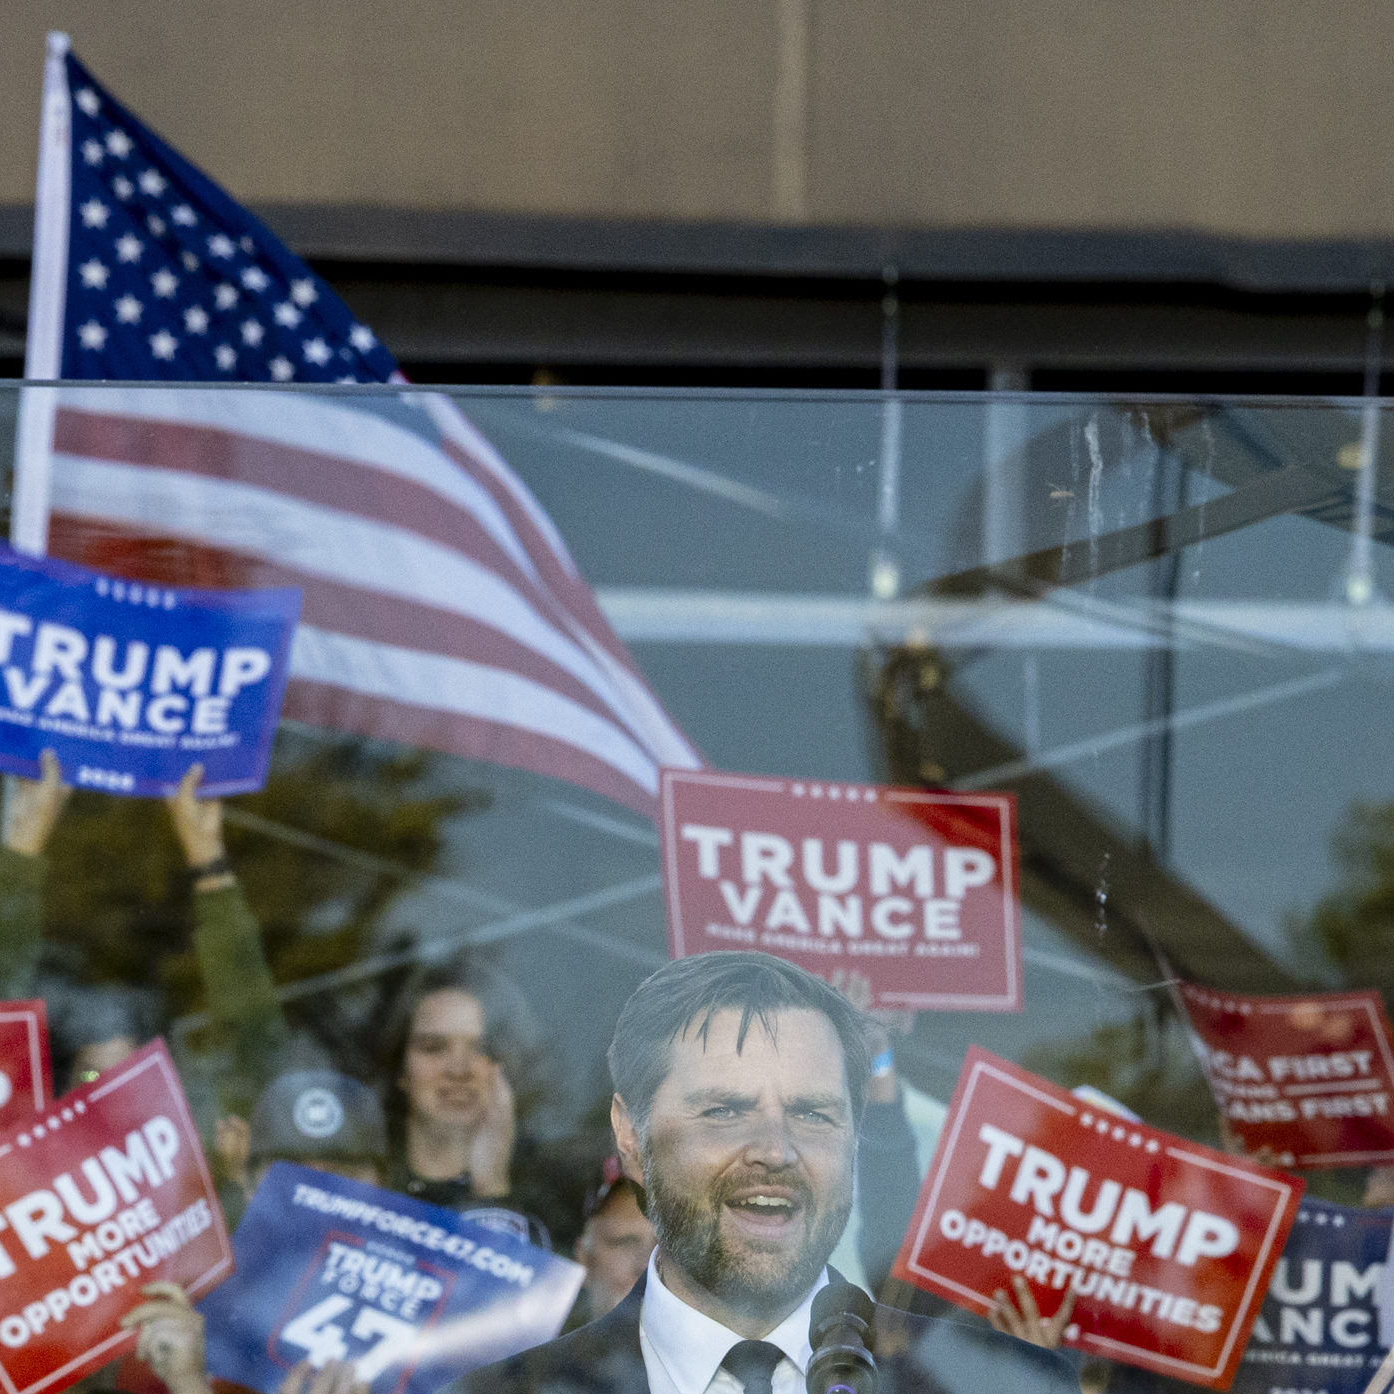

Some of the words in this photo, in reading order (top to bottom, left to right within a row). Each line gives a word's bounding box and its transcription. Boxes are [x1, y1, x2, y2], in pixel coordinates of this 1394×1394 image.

[4, 667, 230, 735] VANCE
[681, 824, 996, 900] TRUMP
[719, 881, 963, 940] VANCE
[976, 1122, 1241, 1269] TRUMP
[66, 1197, 162, 1272] MORE
[292, 1183, 535, 1288] TRUMPFORCE47.COM
[327, 1240, 433, 1303] TRUMP
[939, 1208, 1225, 1335] OPPORTUNITIES
[1028, 1217, 1137, 1278] MORE
[320, 1264, 422, 1319] FORCE
[280, 1293, 419, 1383] 47
